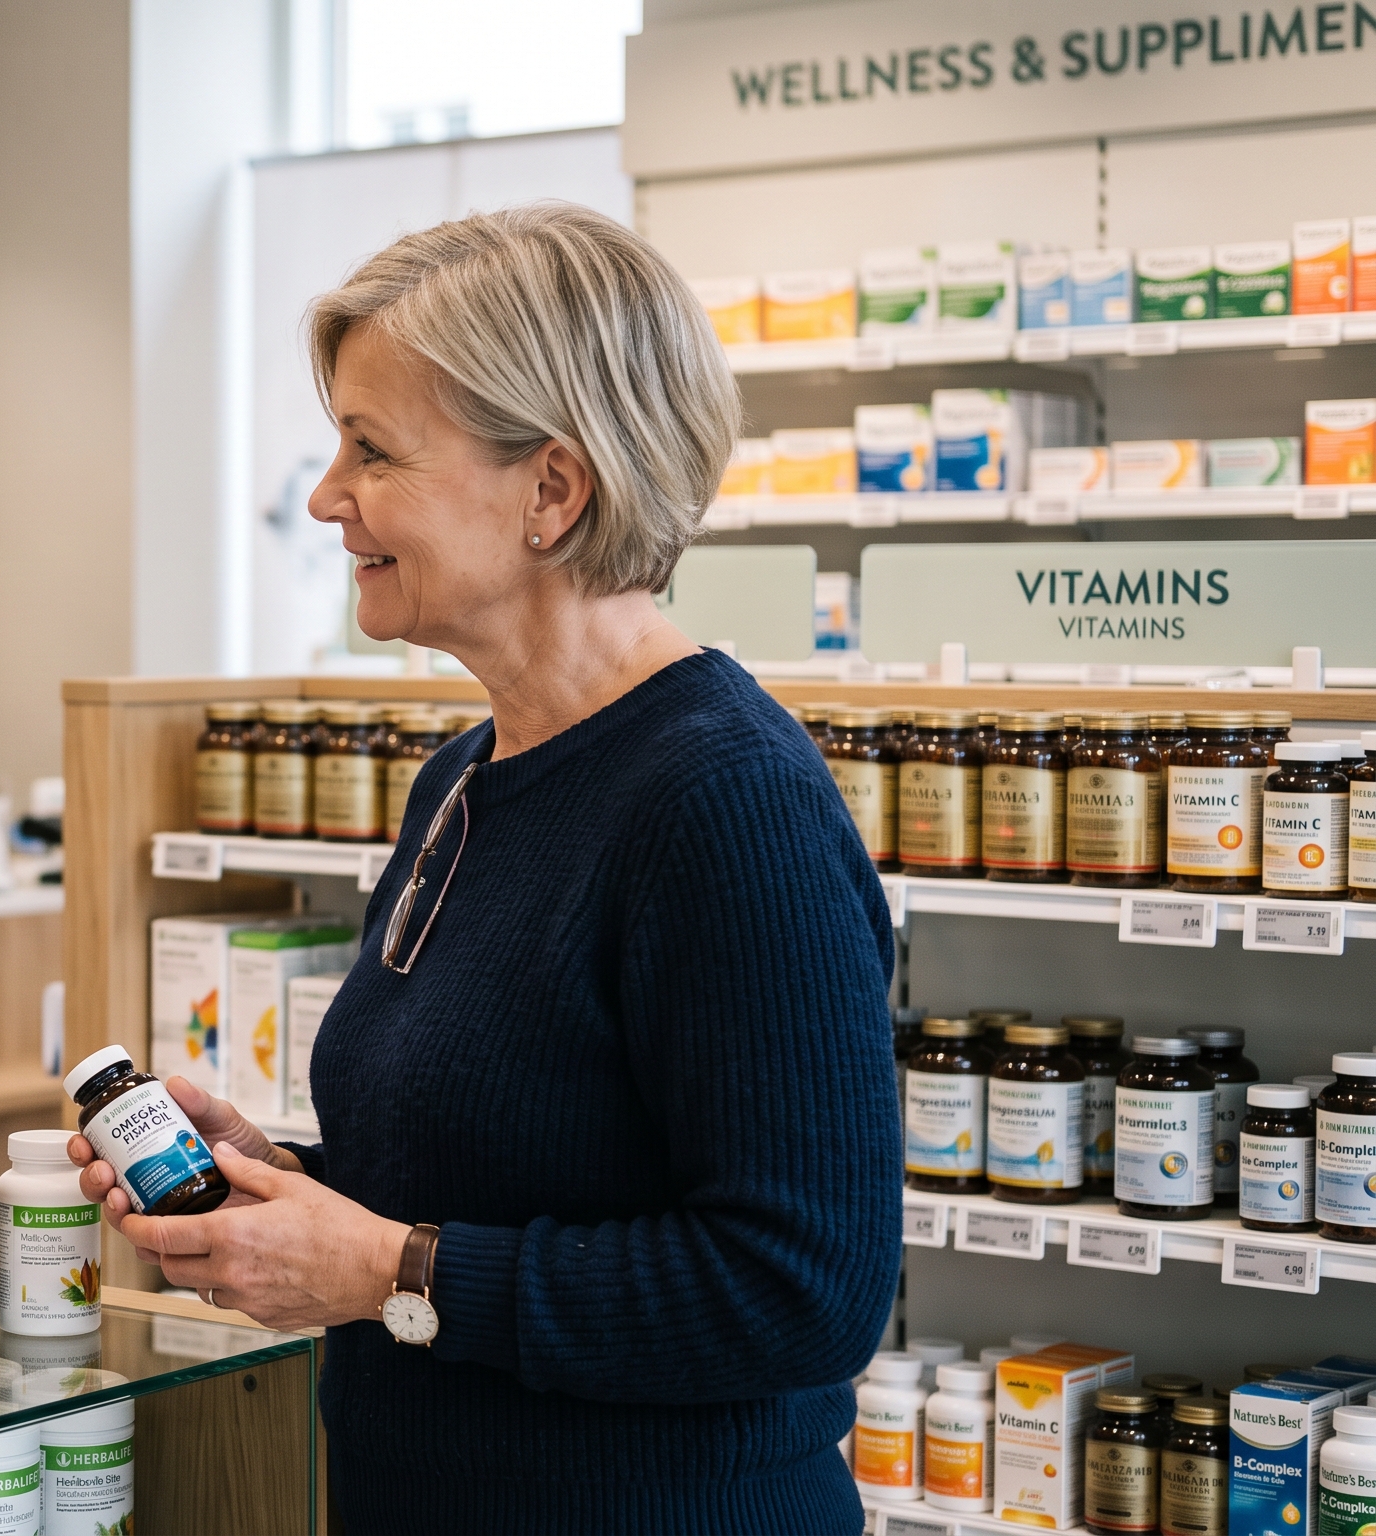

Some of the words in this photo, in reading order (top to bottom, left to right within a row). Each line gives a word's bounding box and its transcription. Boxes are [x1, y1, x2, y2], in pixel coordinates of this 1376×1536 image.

[730, 42, 996, 113] WELLNESS
[1010, 36, 1047, 85] &
[1016, 569, 1230, 606] VITAMINS
[1058, 616, 1185, 639] VITAMINS
[1173, 793, 1226, 806] VITAMIN
[1231, 794, 1239, 806] C
[1312, 818, 1321, 830] C
[151, 1112, 172, 1126] OIL
[999, 1413, 1046, 1432] Vitamin
[1050, 1421, 1059, 1434] C
[1233, 1408, 1277, 1426] Nature's
[1278, 1414, 1303, 1430] Best
[74, 1445, 132, 1466] HERBALIFE
[1233, 1455, 1302, 1478] B-Complex
